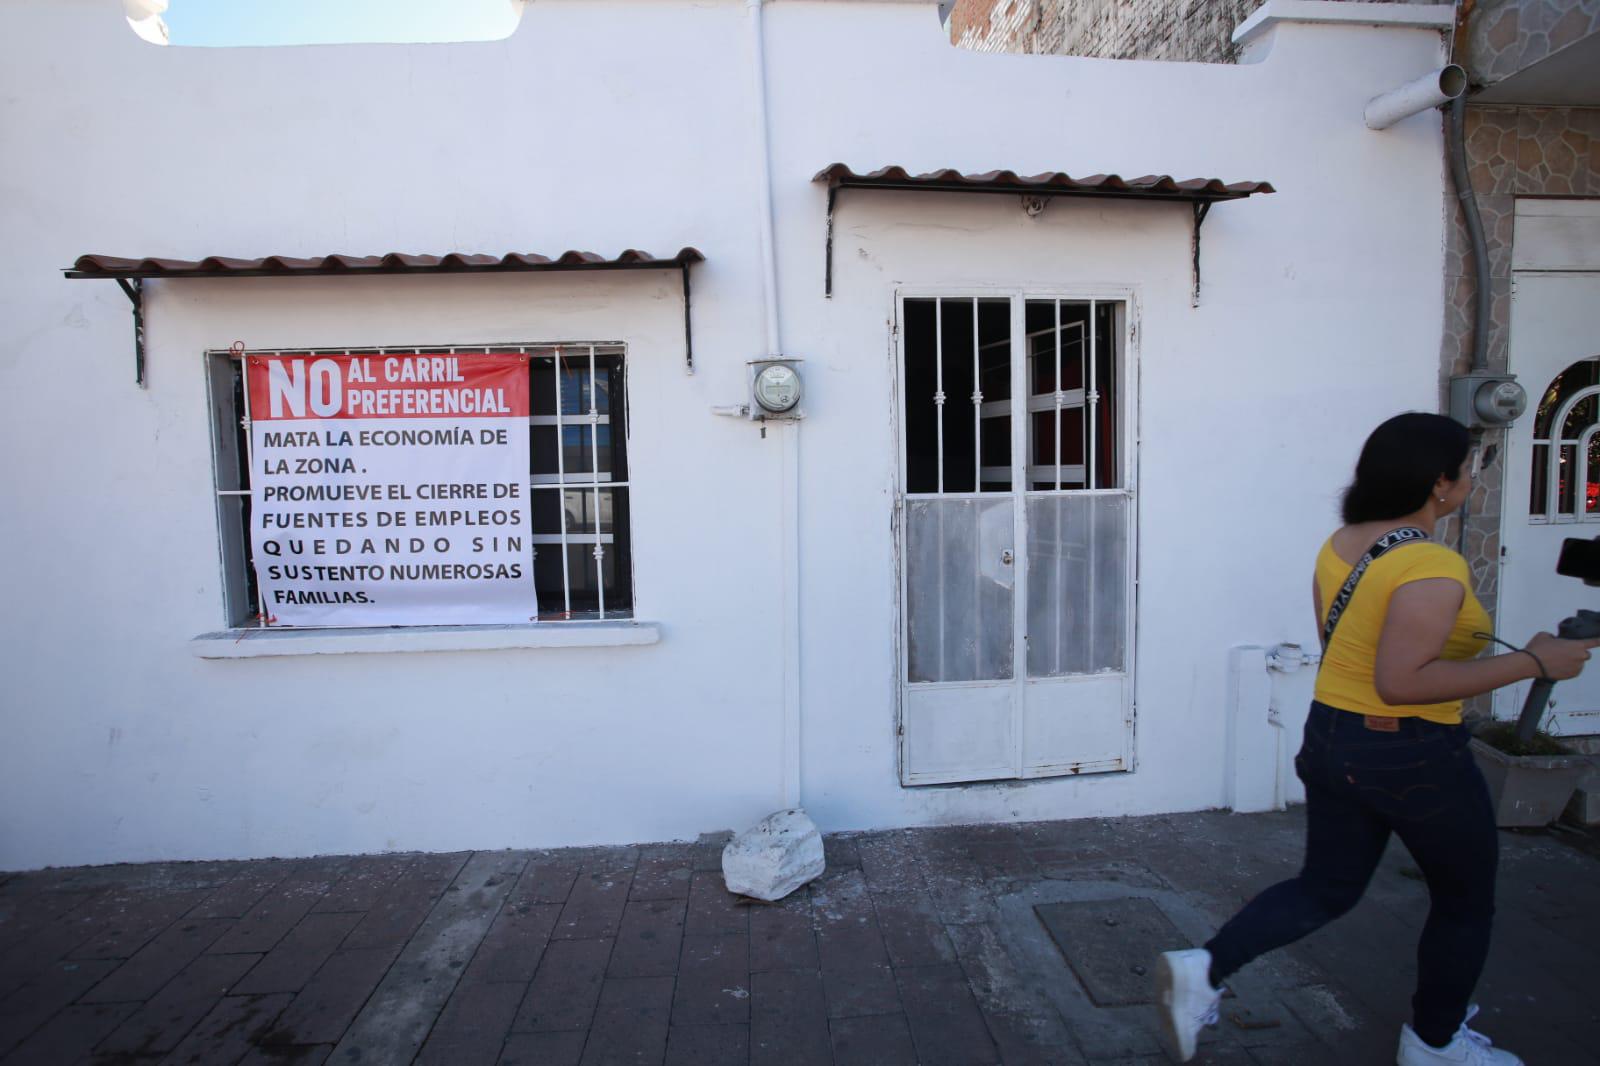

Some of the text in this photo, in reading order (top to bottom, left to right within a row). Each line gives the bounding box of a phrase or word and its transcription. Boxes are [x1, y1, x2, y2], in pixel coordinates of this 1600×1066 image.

[347, 357, 465, 383] AL CARRIL
[268, 358, 343, 418] NO
[347, 388, 511, 415] PREFERENCIAL
[263, 426, 508, 448] MATA LA ECONOMÍA DE
[264, 459, 290, 475] LA
[263, 483, 520, 502] PROMUEVE EL CIERRE DE
[262, 509, 521, 529] FUENTES DE EMPLEOS
[262, 536, 522, 557] QUEDANDO SIN
[268, 563, 522, 581] SUSTENTO NUMEROSAS
[273, 590, 376, 605] FAMILIAS.
